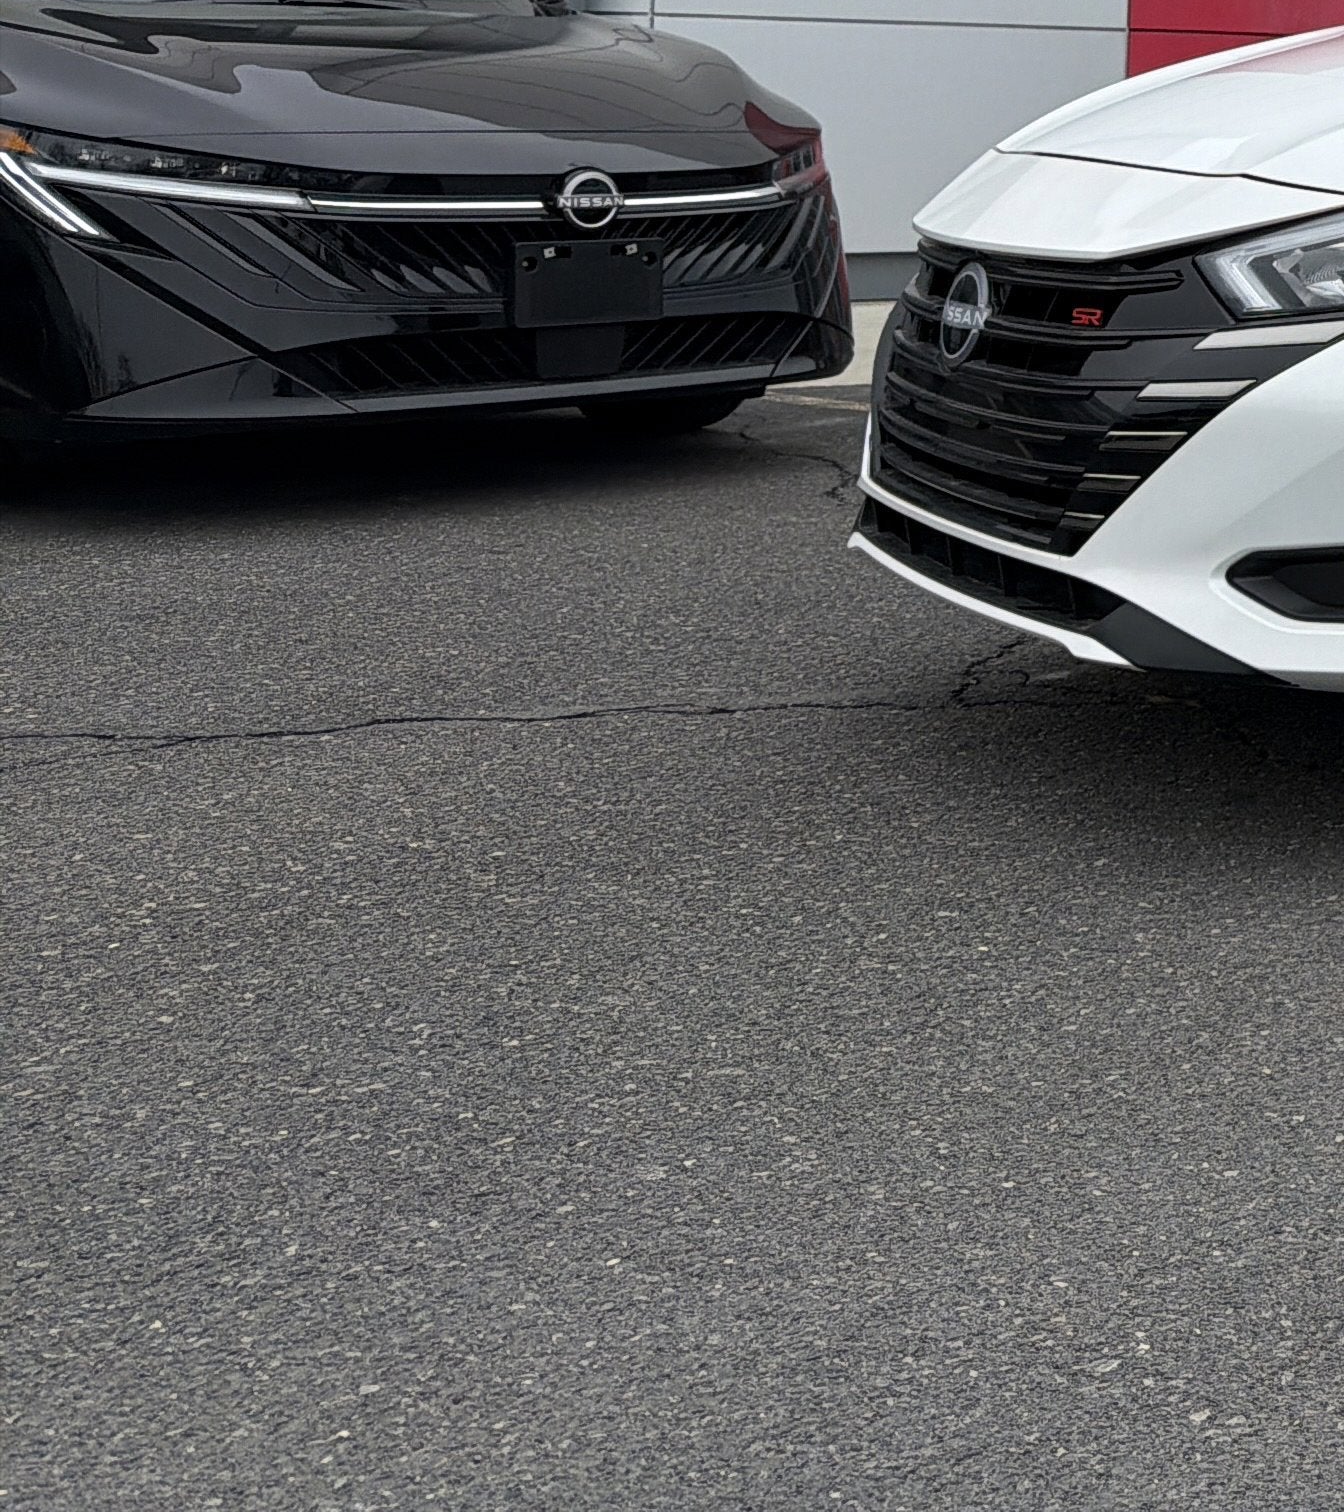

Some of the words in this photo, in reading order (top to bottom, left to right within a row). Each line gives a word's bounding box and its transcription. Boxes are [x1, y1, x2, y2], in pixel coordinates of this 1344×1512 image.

[558, 197, 624, 208] NISSAN
[945, 306, 988, 326] SSAN
[1071, 307, 1102, 326] SR
